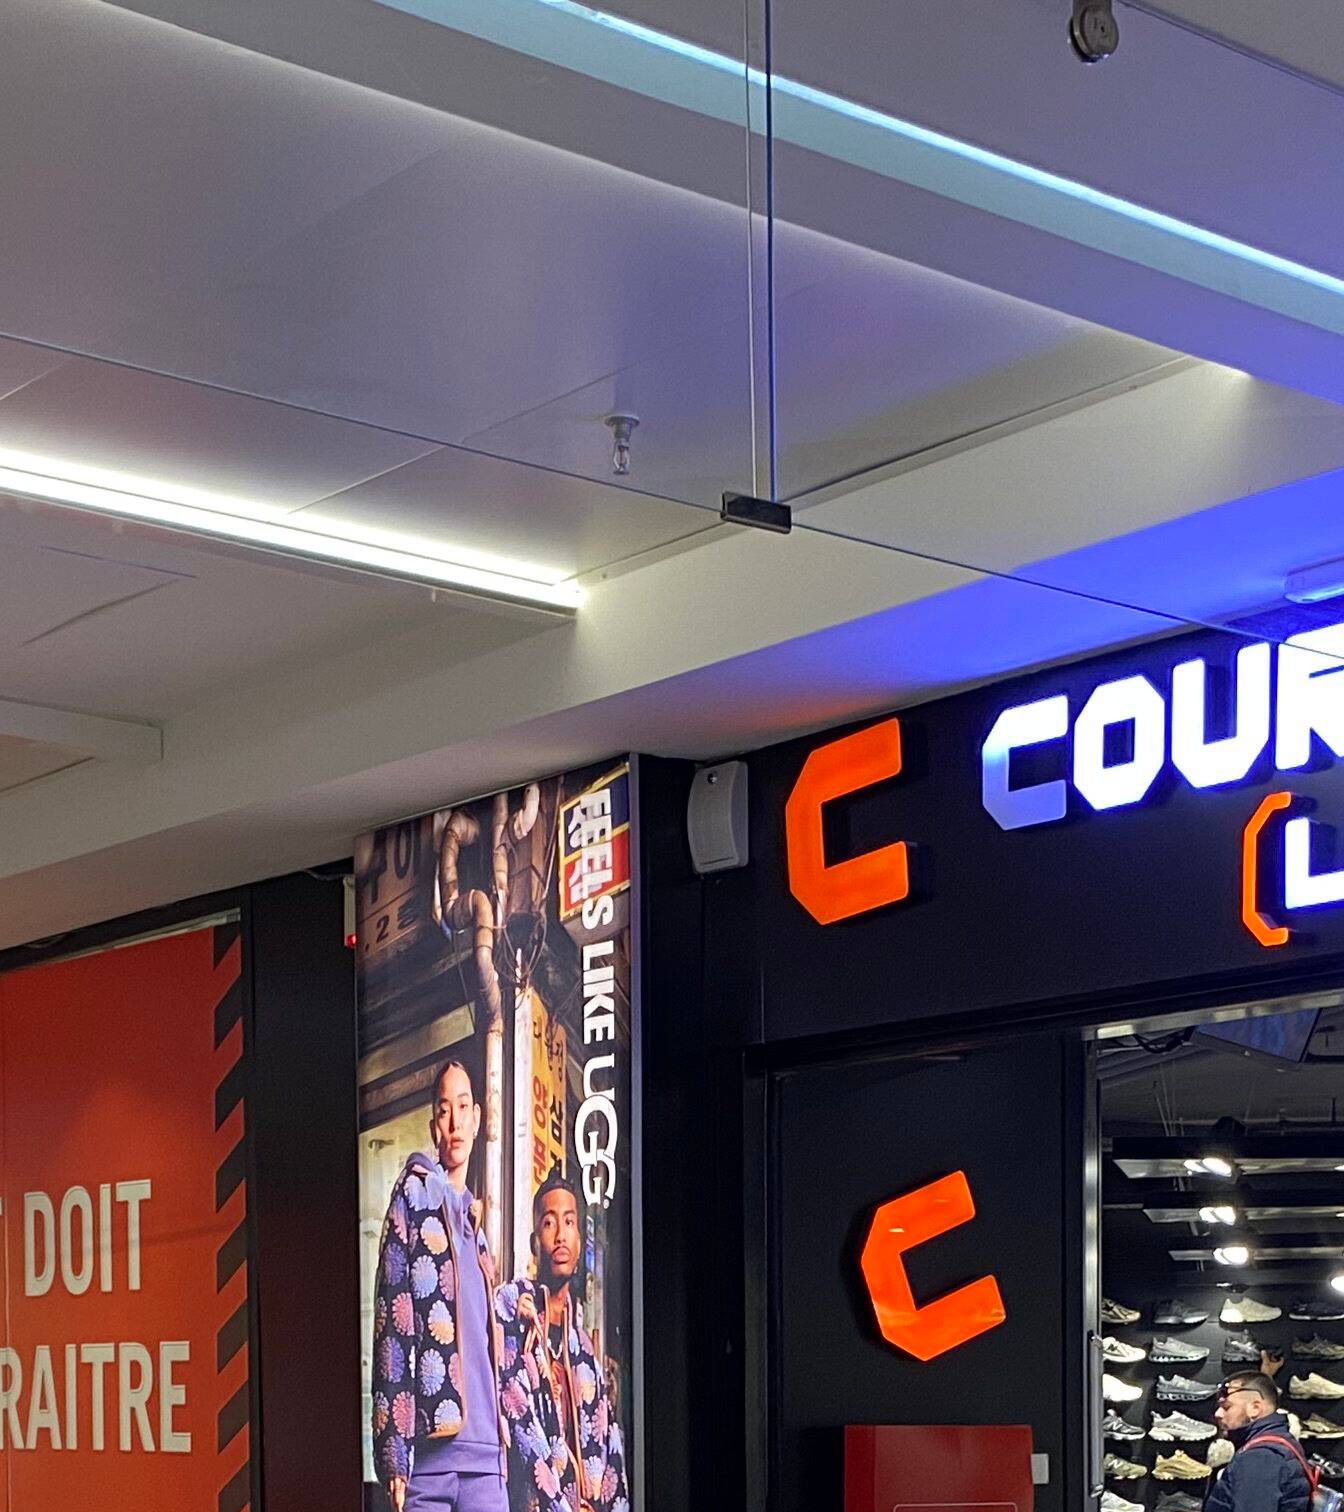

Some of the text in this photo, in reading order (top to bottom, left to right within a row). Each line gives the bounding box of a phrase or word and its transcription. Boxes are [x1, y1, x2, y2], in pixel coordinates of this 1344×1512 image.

[786, 717, 908, 925] C
[574, 788, 618, 1208] FEELS LIKE UGG
[24, 1179, 152, 1296] DOIT
[862, 1170, 1006, 1362] C
